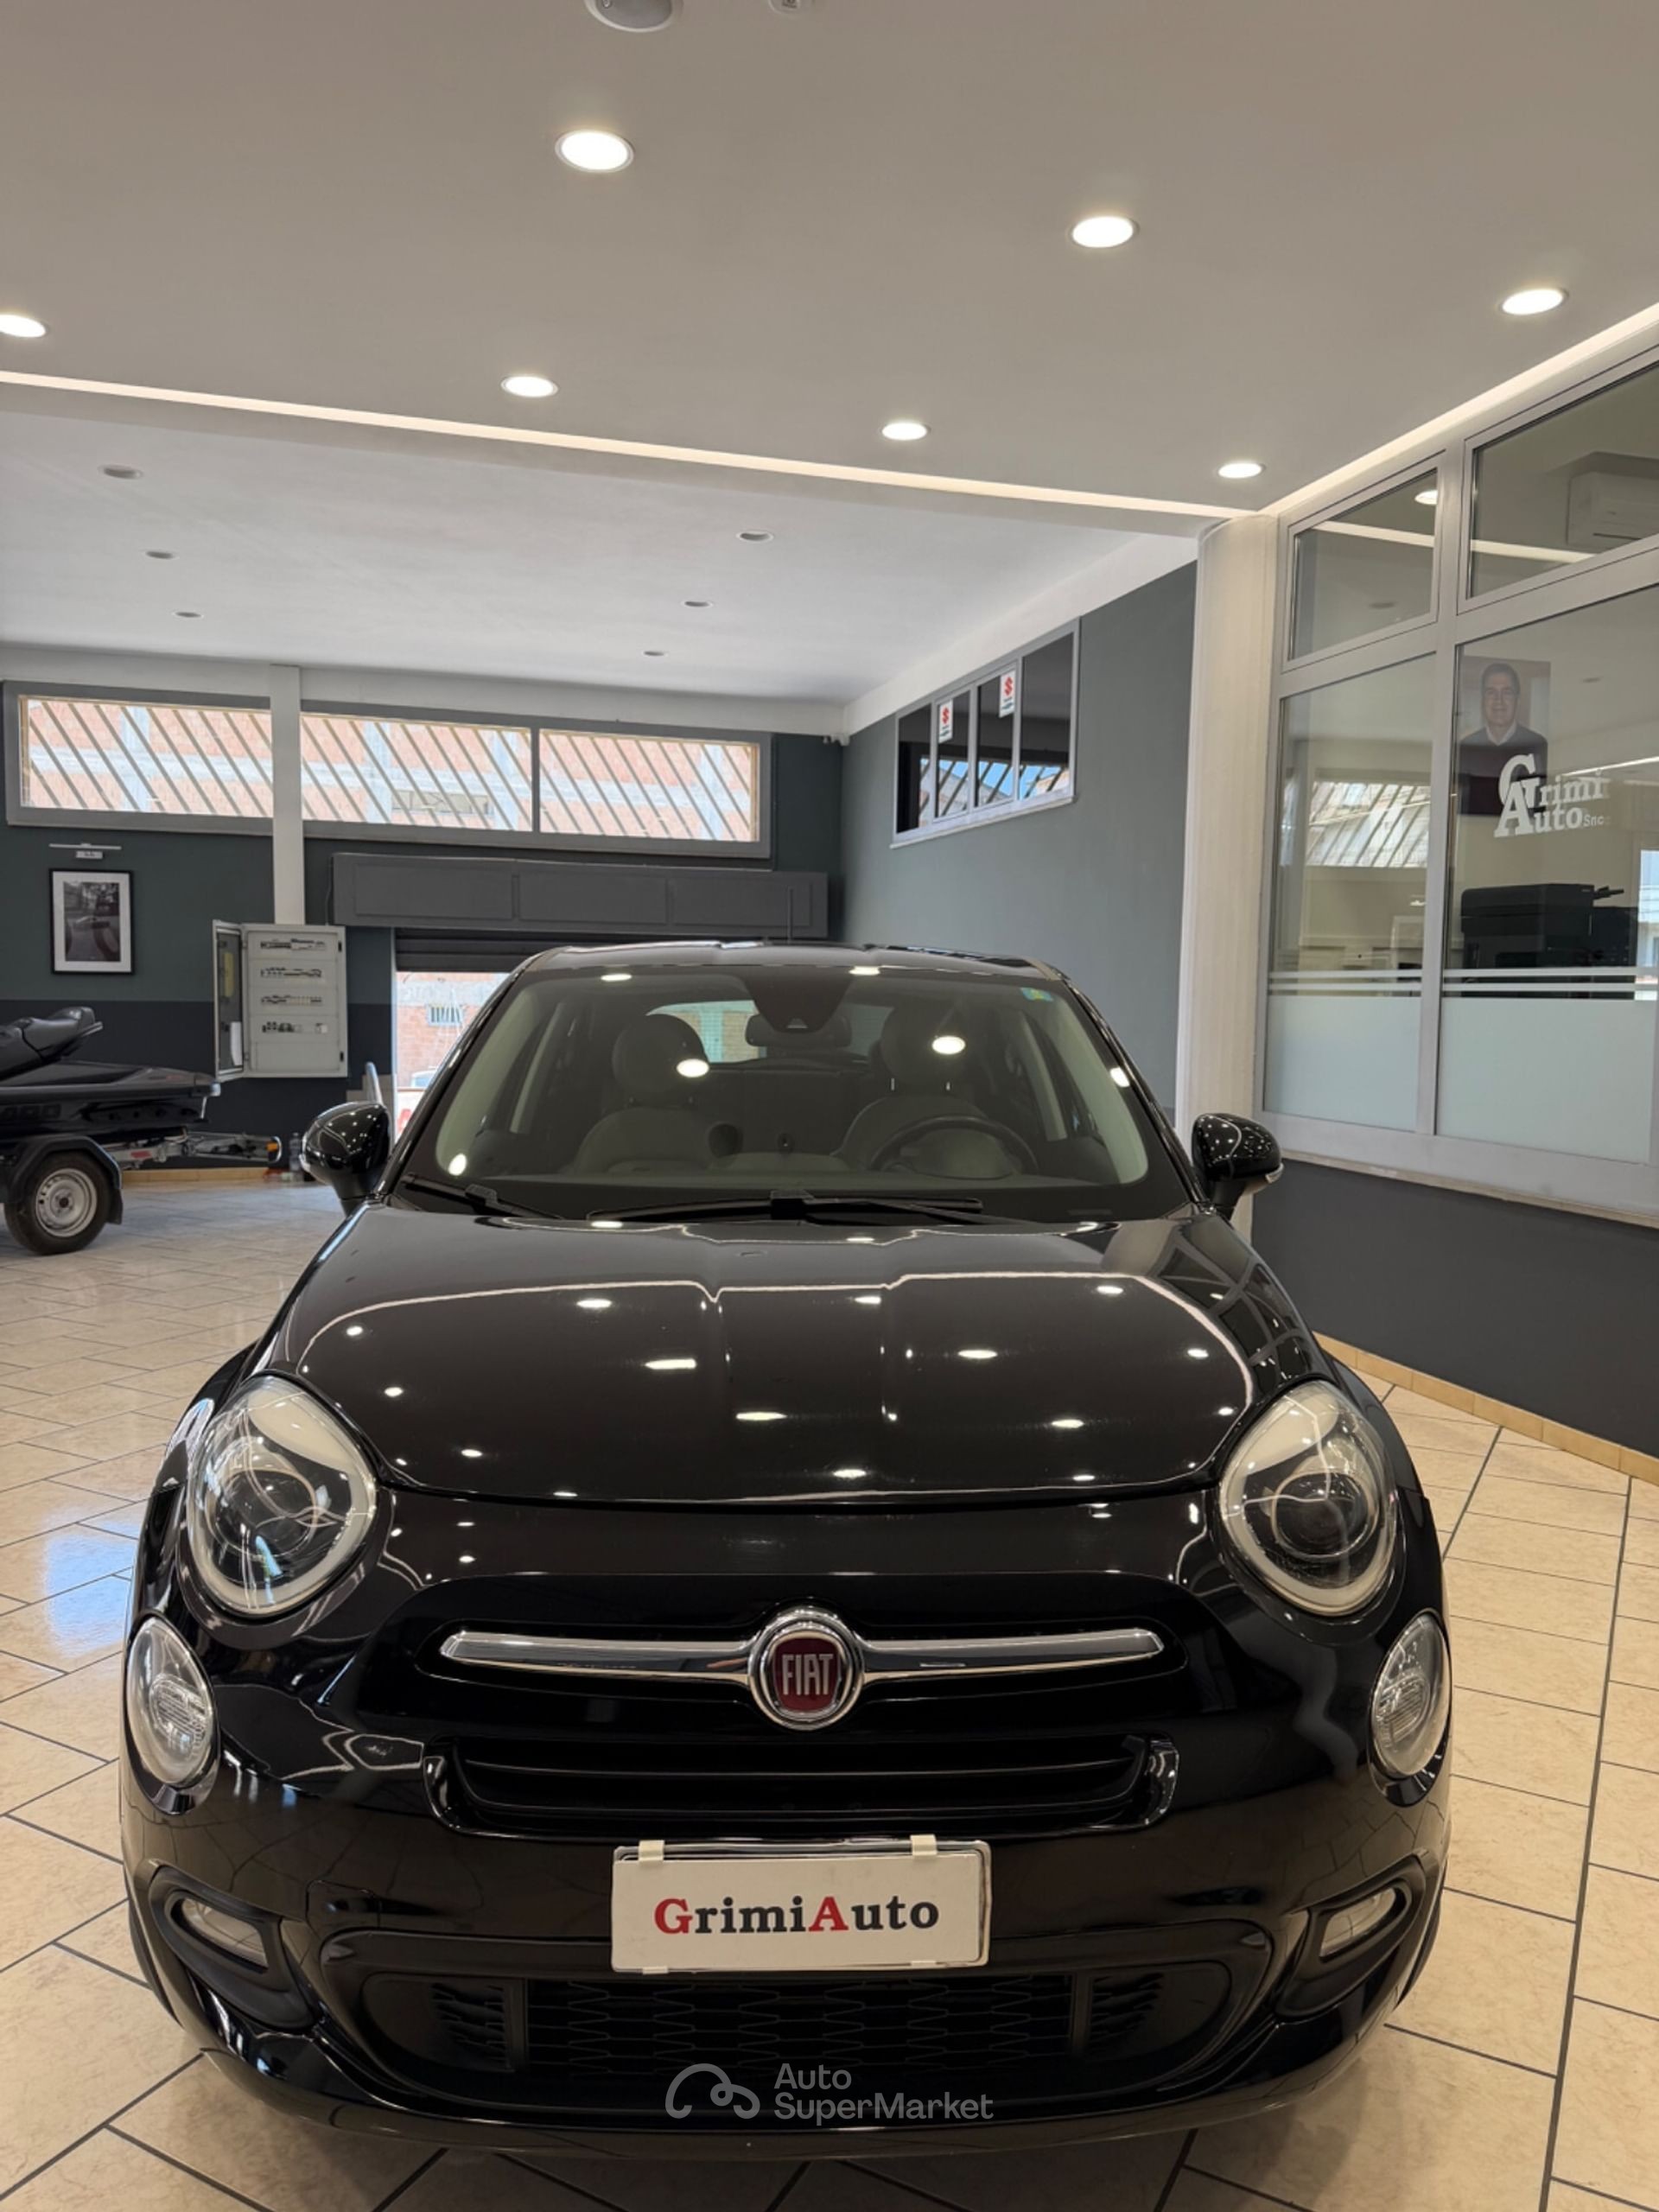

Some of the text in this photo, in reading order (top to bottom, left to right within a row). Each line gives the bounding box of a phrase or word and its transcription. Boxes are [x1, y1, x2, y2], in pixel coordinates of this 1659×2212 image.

[1498, 753, 1605, 808] Grimi
[1494, 780, 1583, 837] Auto
[782, 1653, 834, 1695] FIAT
[654, 1895, 939, 1935] GrimiAuto
